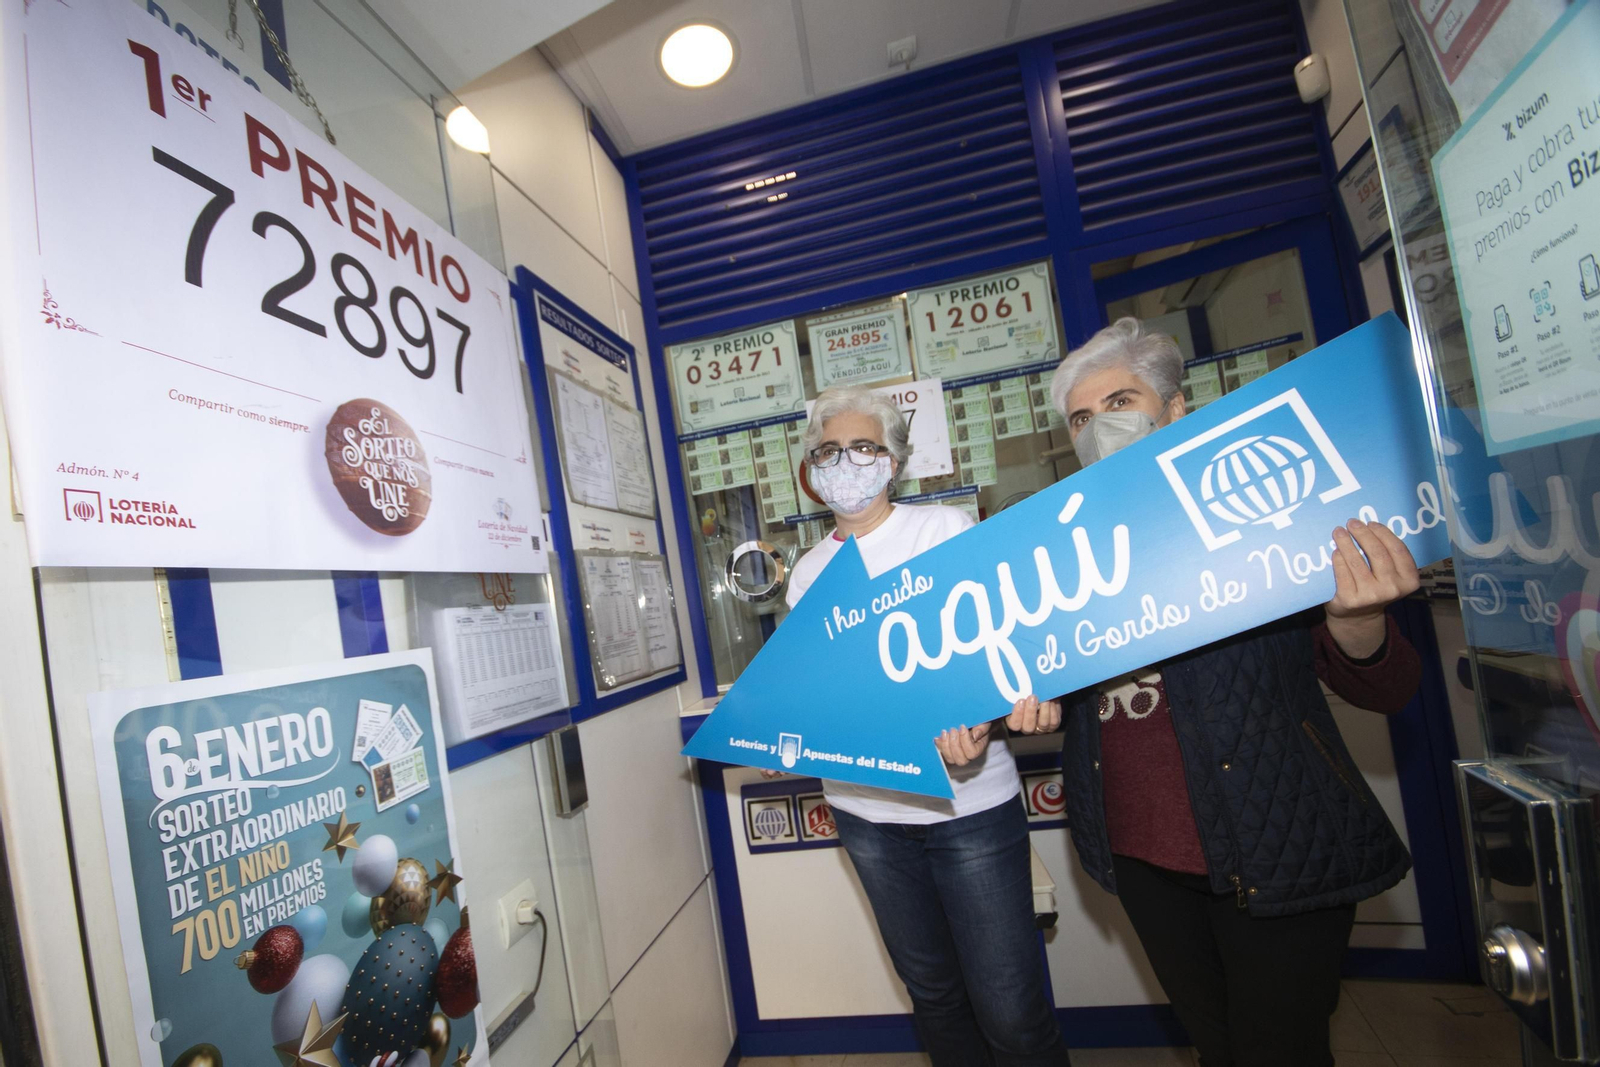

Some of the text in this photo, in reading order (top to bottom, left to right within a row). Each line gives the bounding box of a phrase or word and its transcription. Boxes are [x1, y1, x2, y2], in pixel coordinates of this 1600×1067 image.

[1515, 92, 1549, 131] bizum
[1475, 177, 1512, 217] Paga
[1516, 167, 1524, 192] y
[1528, 123, 1575, 174] cobra
[245, 112, 470, 304] PREMIO
[1474, 206, 1531, 264] premios
[1534, 180, 1565, 216] con
[1567, 148, 1600, 189] Biz
[152, 146, 471, 394] 72897
[950, 276, 1020, 304] PREMIO
[540, 303, 595, 348] RESULTADOS
[824, 319, 887, 339] GRAN PREMIO
[926, 291, 1033, 333] 12061
[713, 331, 775, 357] PREMIO
[826, 329, 881, 352] 24.895
[1497, 347, 1509, 360] Paso
[1537, 325, 1561, 342] Paso #2
[686, 346, 782, 385] 03471
[830, 366, 869, 380] VENDIDO
[168, 389, 312, 434] Compartir como siempre.
[342, 427, 416, 467] SORTEO
[56, 462, 109, 478] Admón.
[131, 471, 140, 482] 4
[364, 460, 420, 488] QUE NOS
[109, 498, 178, 515] LOTERÍA
[359, 476, 410, 522] UNE
[110, 512, 197, 529] NACIONAL
[878, 491, 1131, 705] aquí
[1036, 634, 1067, 675] el
[1075, 593, 1190, 657] Gordo
[1199, 569, 1247, 613] de
[145, 725, 188, 801] 6
[186, 759, 198, 775] de
[193, 706, 334, 786] ENERO
[729, 736, 922, 776] Loterías y Apuestas del Estado
[158, 787, 252, 844] SORTEO
[162, 786, 347, 881] EXTRAORDINARIO
[167, 841, 291, 919] DE EL NIÑO
[171, 858, 324, 975] 700 MILLONES
[242, 881, 327, 939] EN PREMIOS
